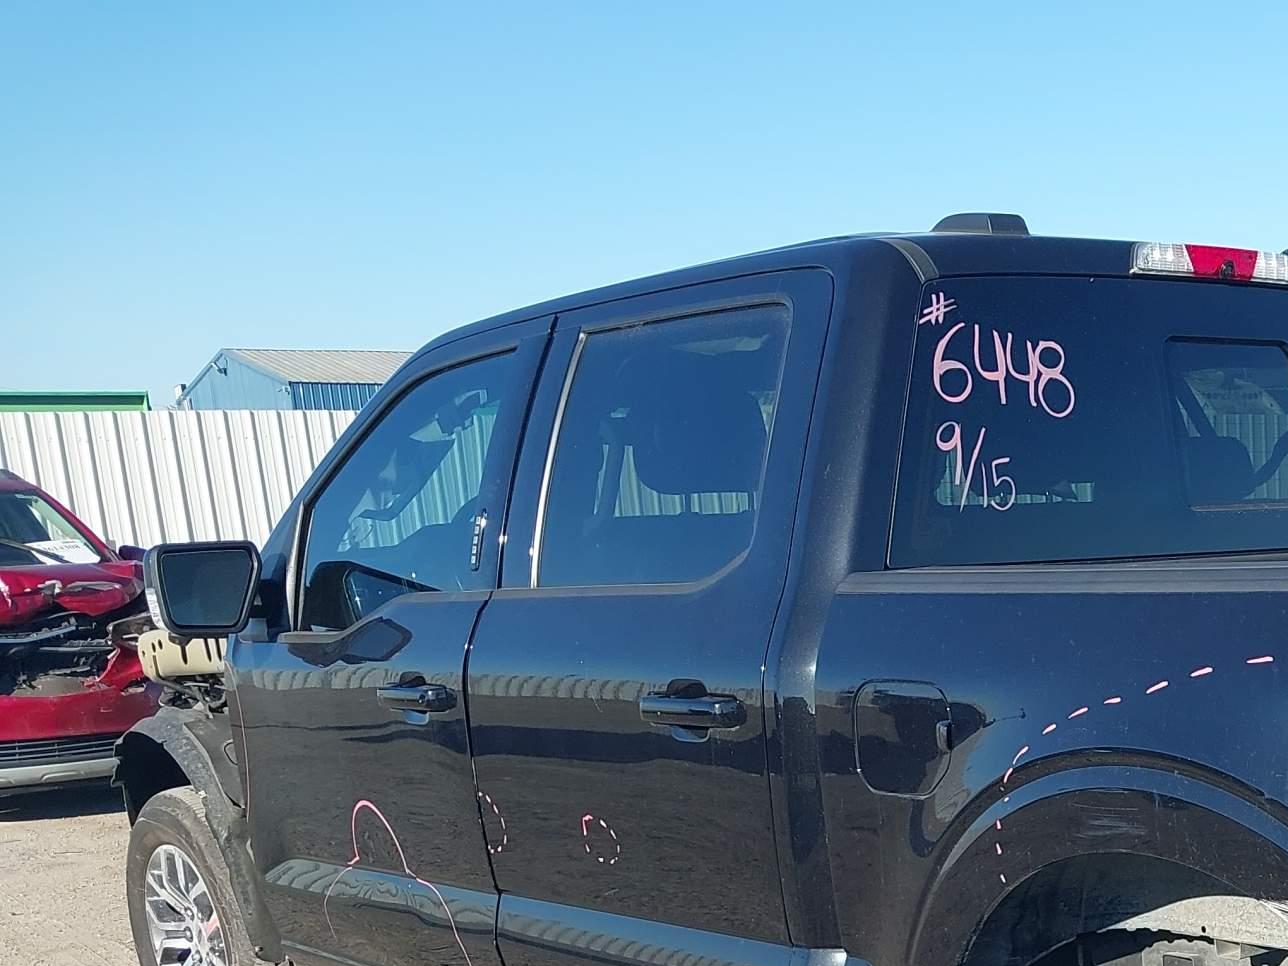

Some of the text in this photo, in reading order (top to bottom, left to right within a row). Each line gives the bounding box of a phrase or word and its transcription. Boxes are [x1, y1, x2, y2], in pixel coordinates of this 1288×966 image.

[919, 292, 957, 325] #
[933, 322, 1075, 418] 6448
[936, 421, 1016, 512] 9/15
